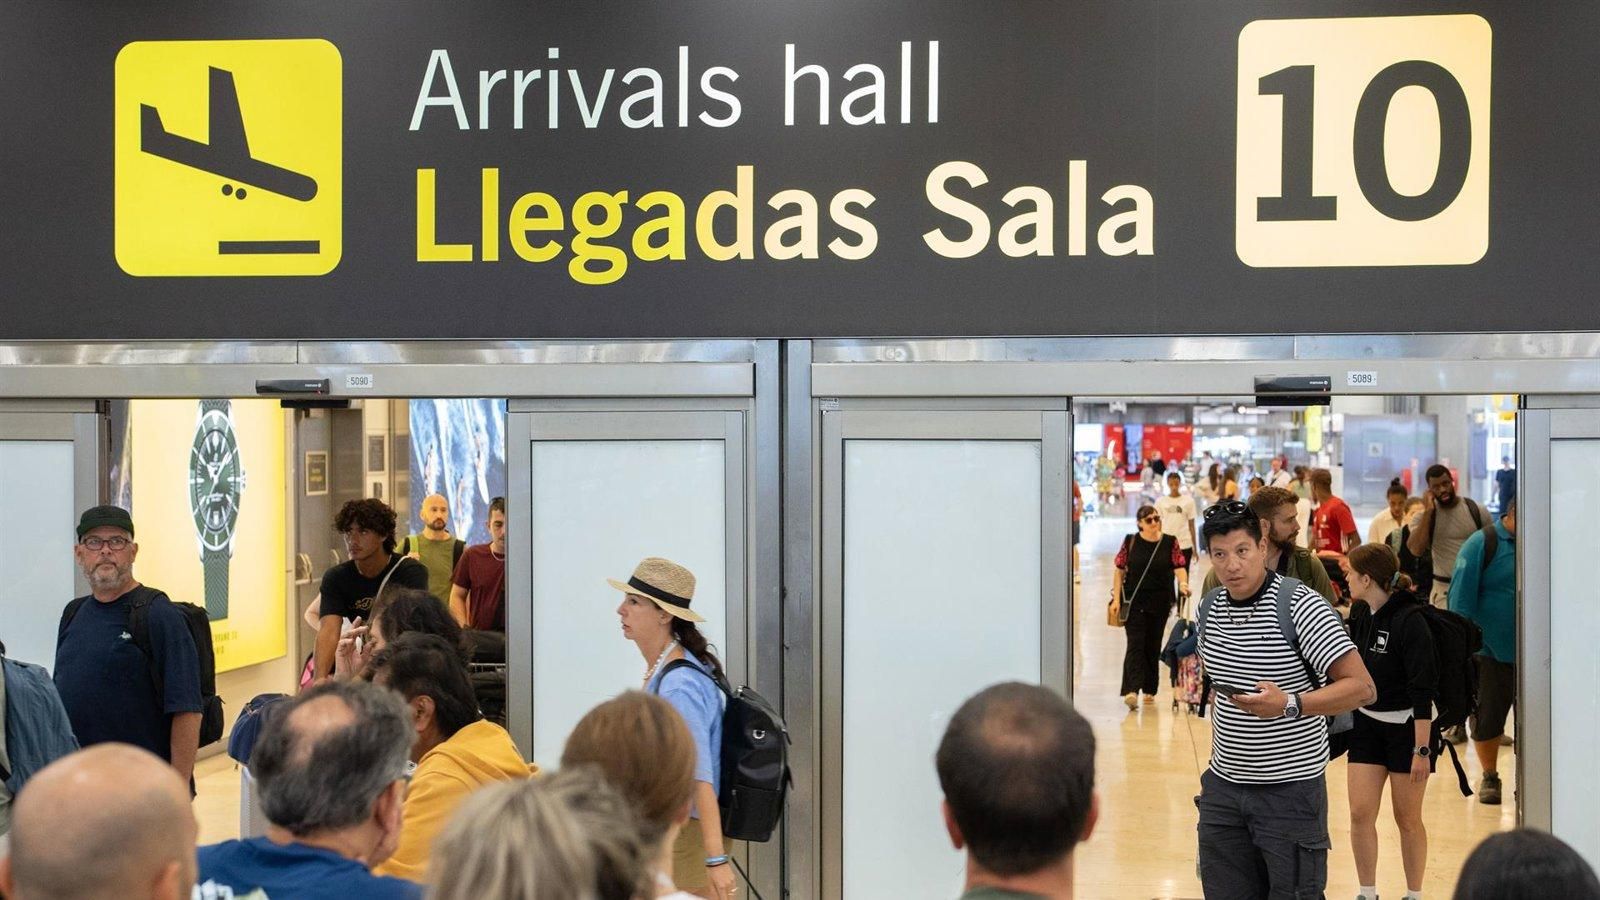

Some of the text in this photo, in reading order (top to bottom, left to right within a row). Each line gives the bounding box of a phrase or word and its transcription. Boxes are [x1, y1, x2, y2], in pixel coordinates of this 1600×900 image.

[409, 40, 940, 131] Arrivals hall
[1256, 59, 1472, 222] 10
[416, 160, 1155, 285] Llegadas Sala
[1352, 374, 1372, 384] 5089
